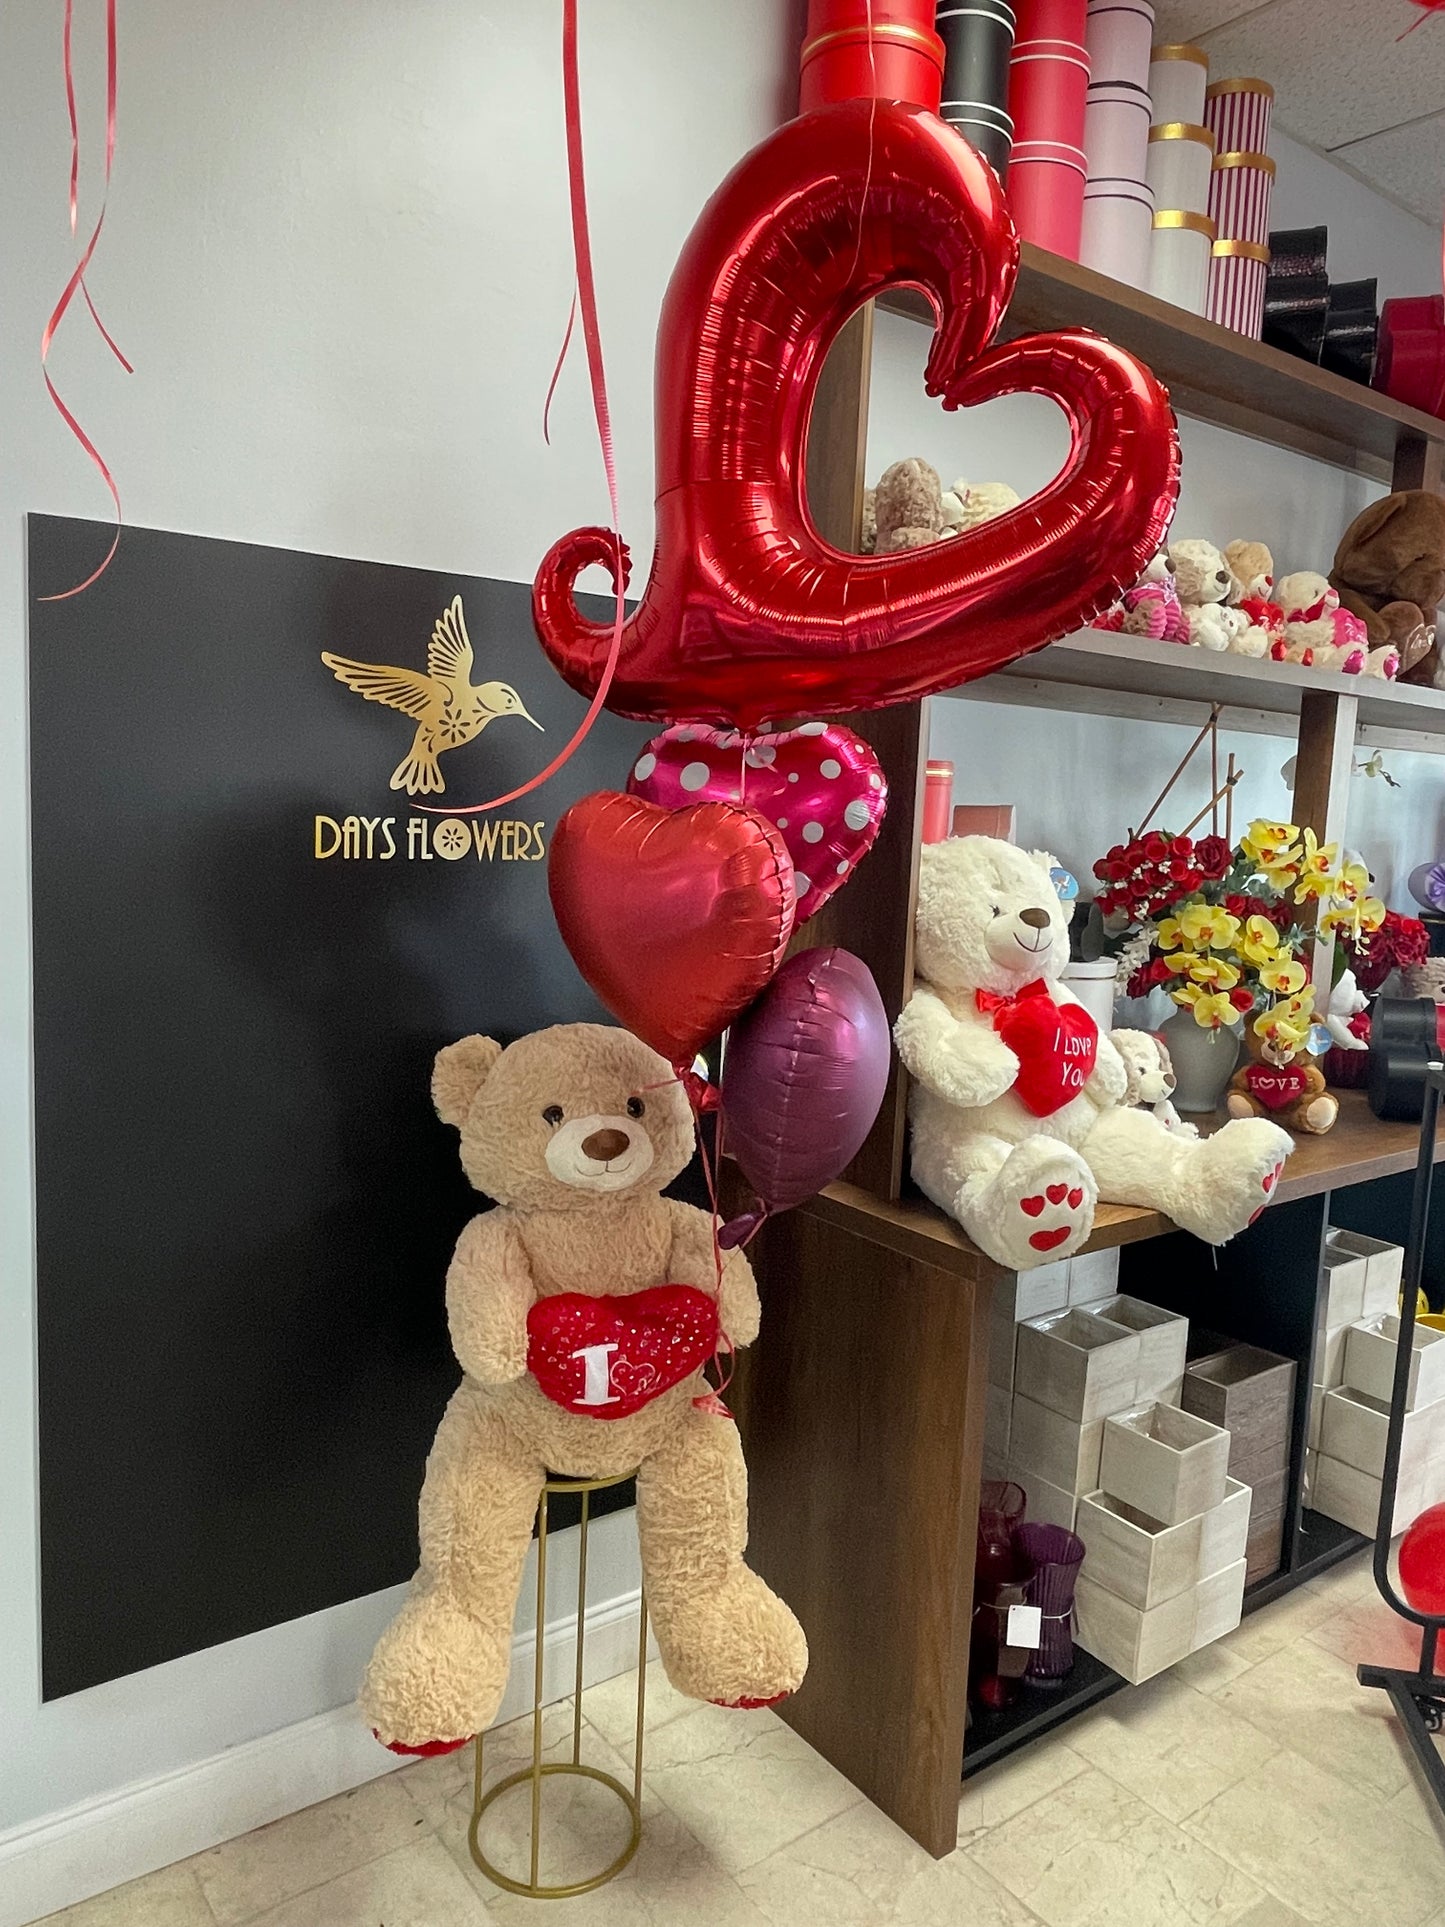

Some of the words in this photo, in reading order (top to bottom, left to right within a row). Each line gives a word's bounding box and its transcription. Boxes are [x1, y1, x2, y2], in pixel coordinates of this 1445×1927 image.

[314, 815, 397, 860] DAYS
[407, 817, 545, 862] FLOWERS
[1053, 1027, 1061, 1052] I
[571, 1342, 621, 1406] I
